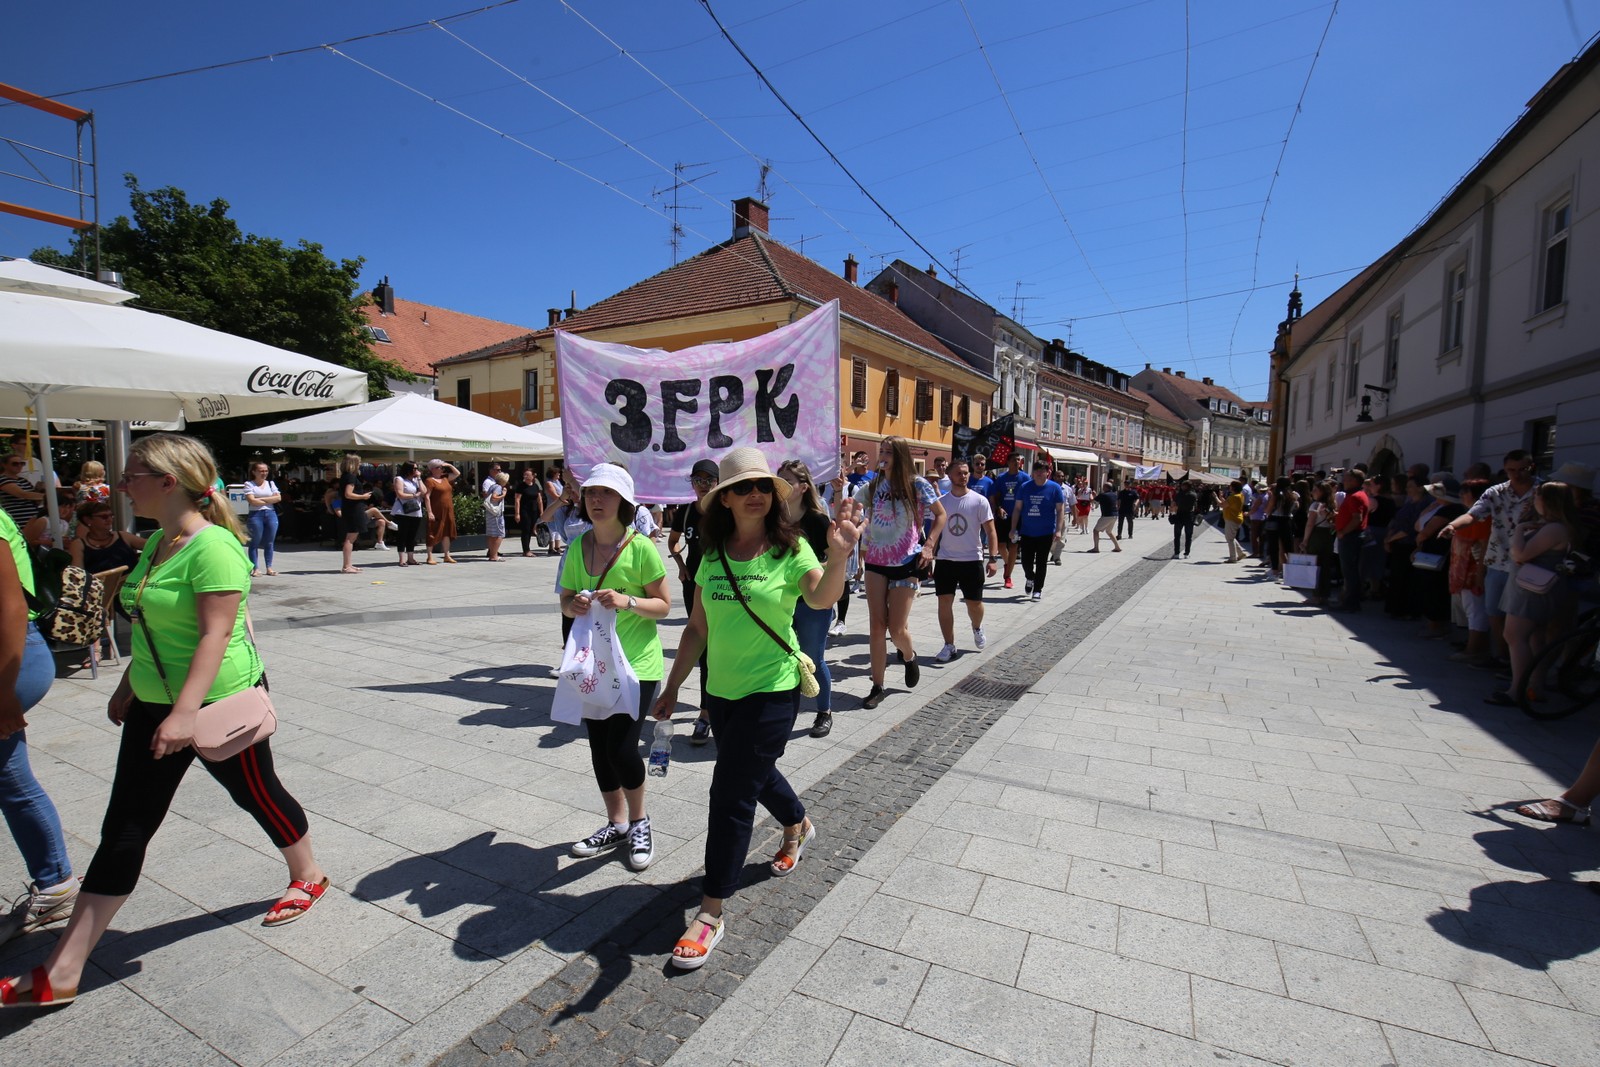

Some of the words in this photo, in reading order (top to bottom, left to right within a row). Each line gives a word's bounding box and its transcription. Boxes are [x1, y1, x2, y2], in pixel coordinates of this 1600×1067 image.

[247, 365, 339, 398] Coca-Cola
[604, 363, 800, 453] 3.FPK
[461, 440, 493, 450] SOMERSBY
